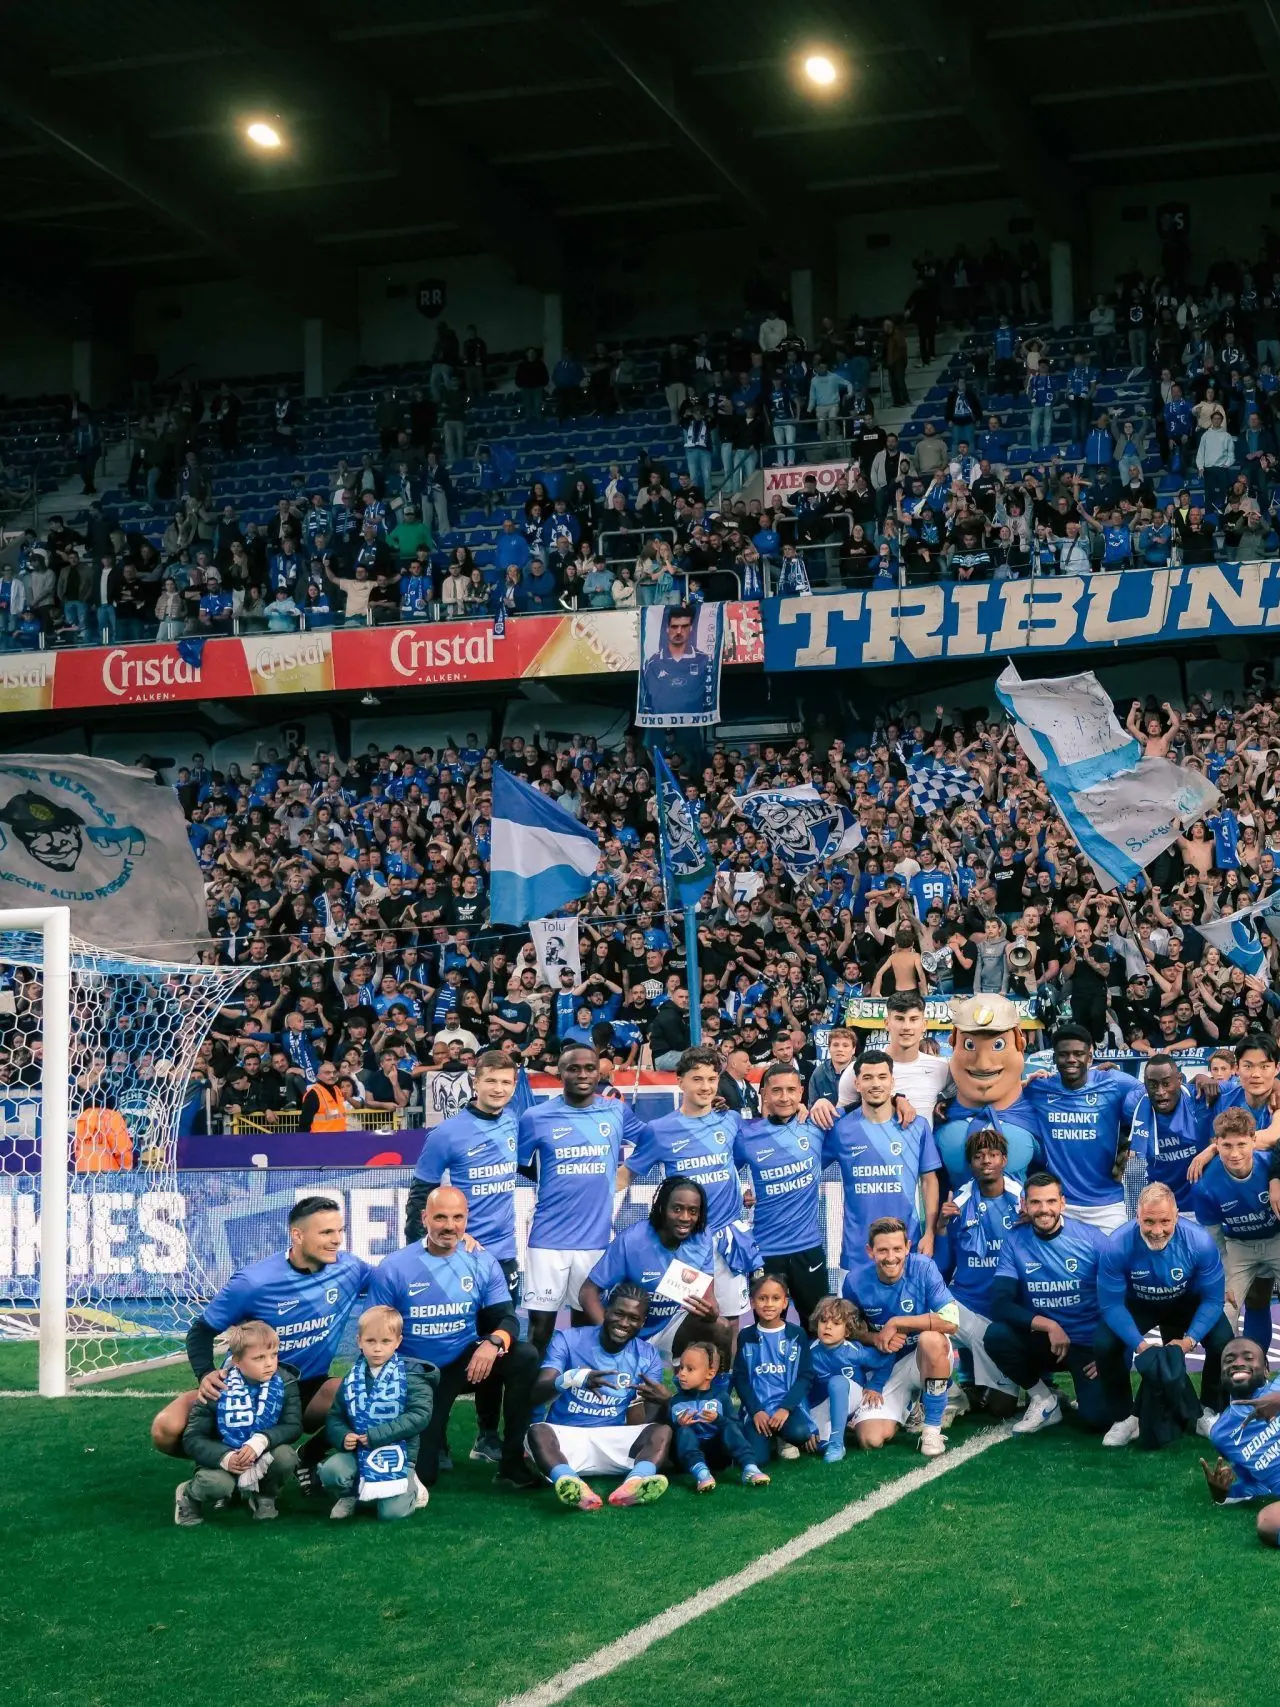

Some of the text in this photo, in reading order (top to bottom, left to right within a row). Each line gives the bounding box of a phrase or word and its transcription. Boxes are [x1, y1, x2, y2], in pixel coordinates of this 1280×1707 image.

[420, 289, 442, 305] RR
[256, 640, 325, 679] Cristal
[390, 628, 495, 677] Cristal
[103, 649, 201, 695] Cristal
[425, 673, 462, 683] ALKEN
[135, 692, 170, 702] ALKEN
[641, 714, 714, 725] UNO DI NOI
[922, 882, 944, 899] 99
[541, 921, 567, 932] Tolu
[1048, 1111, 1099, 1124] BEDANKT
[1051, 1129, 1097, 1140] GENKIES
[555, 1144, 611, 1160] BEDANKT
[468, 1160, 518, 1178] BEDANKT
[556, 1162, 607, 1175] GENKIES
[676, 1152, 730, 1171] BEDANKT
[759, 1157, 815, 1180] BEDANKT
[852, 1164, 904, 1177] BEDANKT
[471, 1178, 516, 1196] GENKIES
[765, 1173, 814, 1196] GENKIES
[854, 1182, 902, 1194] GENKIES
[1027, 1279, 1081, 1293] BEDANKT
[1132, 1281, 1188, 1294] BEDANKT
[1032, 1294, 1081, 1308] GENKIES
[409, 1301, 473, 1318] BEDANKT
[276, 1313, 336, 1337] BEDANKT
[412, 1318, 467, 1336] GENKIES
[567, 1401, 619, 1418] GENKIES
